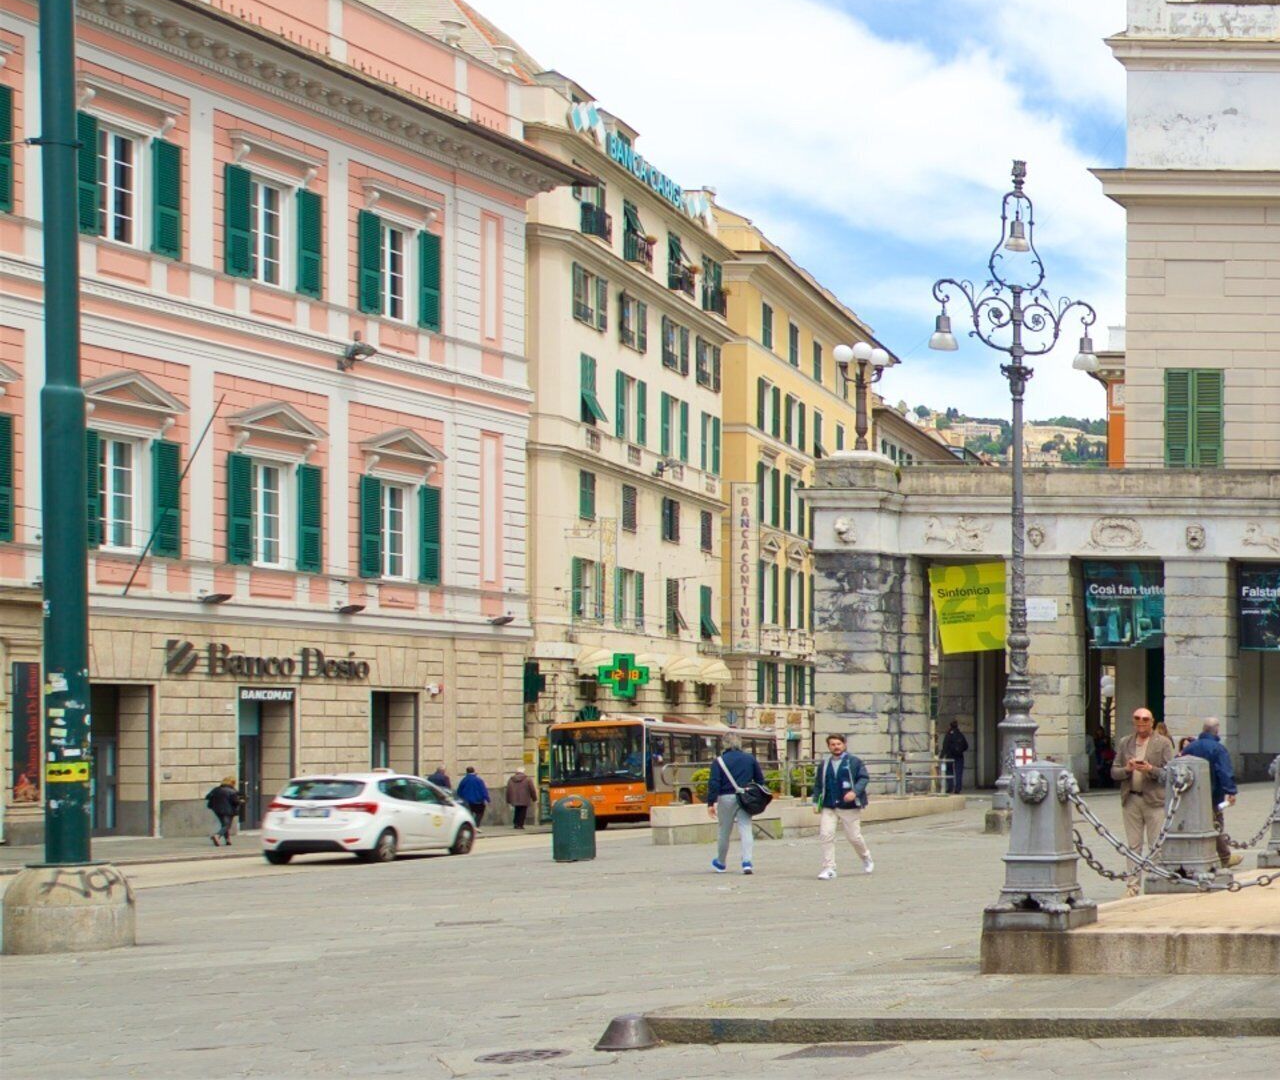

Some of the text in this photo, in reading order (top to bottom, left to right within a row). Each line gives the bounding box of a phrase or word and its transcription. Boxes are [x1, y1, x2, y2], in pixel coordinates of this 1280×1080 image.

[607, 133, 648, 184] BANCA
[740, 495, 750, 640] BANCA CONTINUA
[937, 586, 991, 599] Sinfonica
[1089, 583, 1117, 595] Così
[1118, 584, 1137, 595] fan
[207, 642, 370, 680] Banco Desio
[240, 688, 294, 701] BANCOMAT
